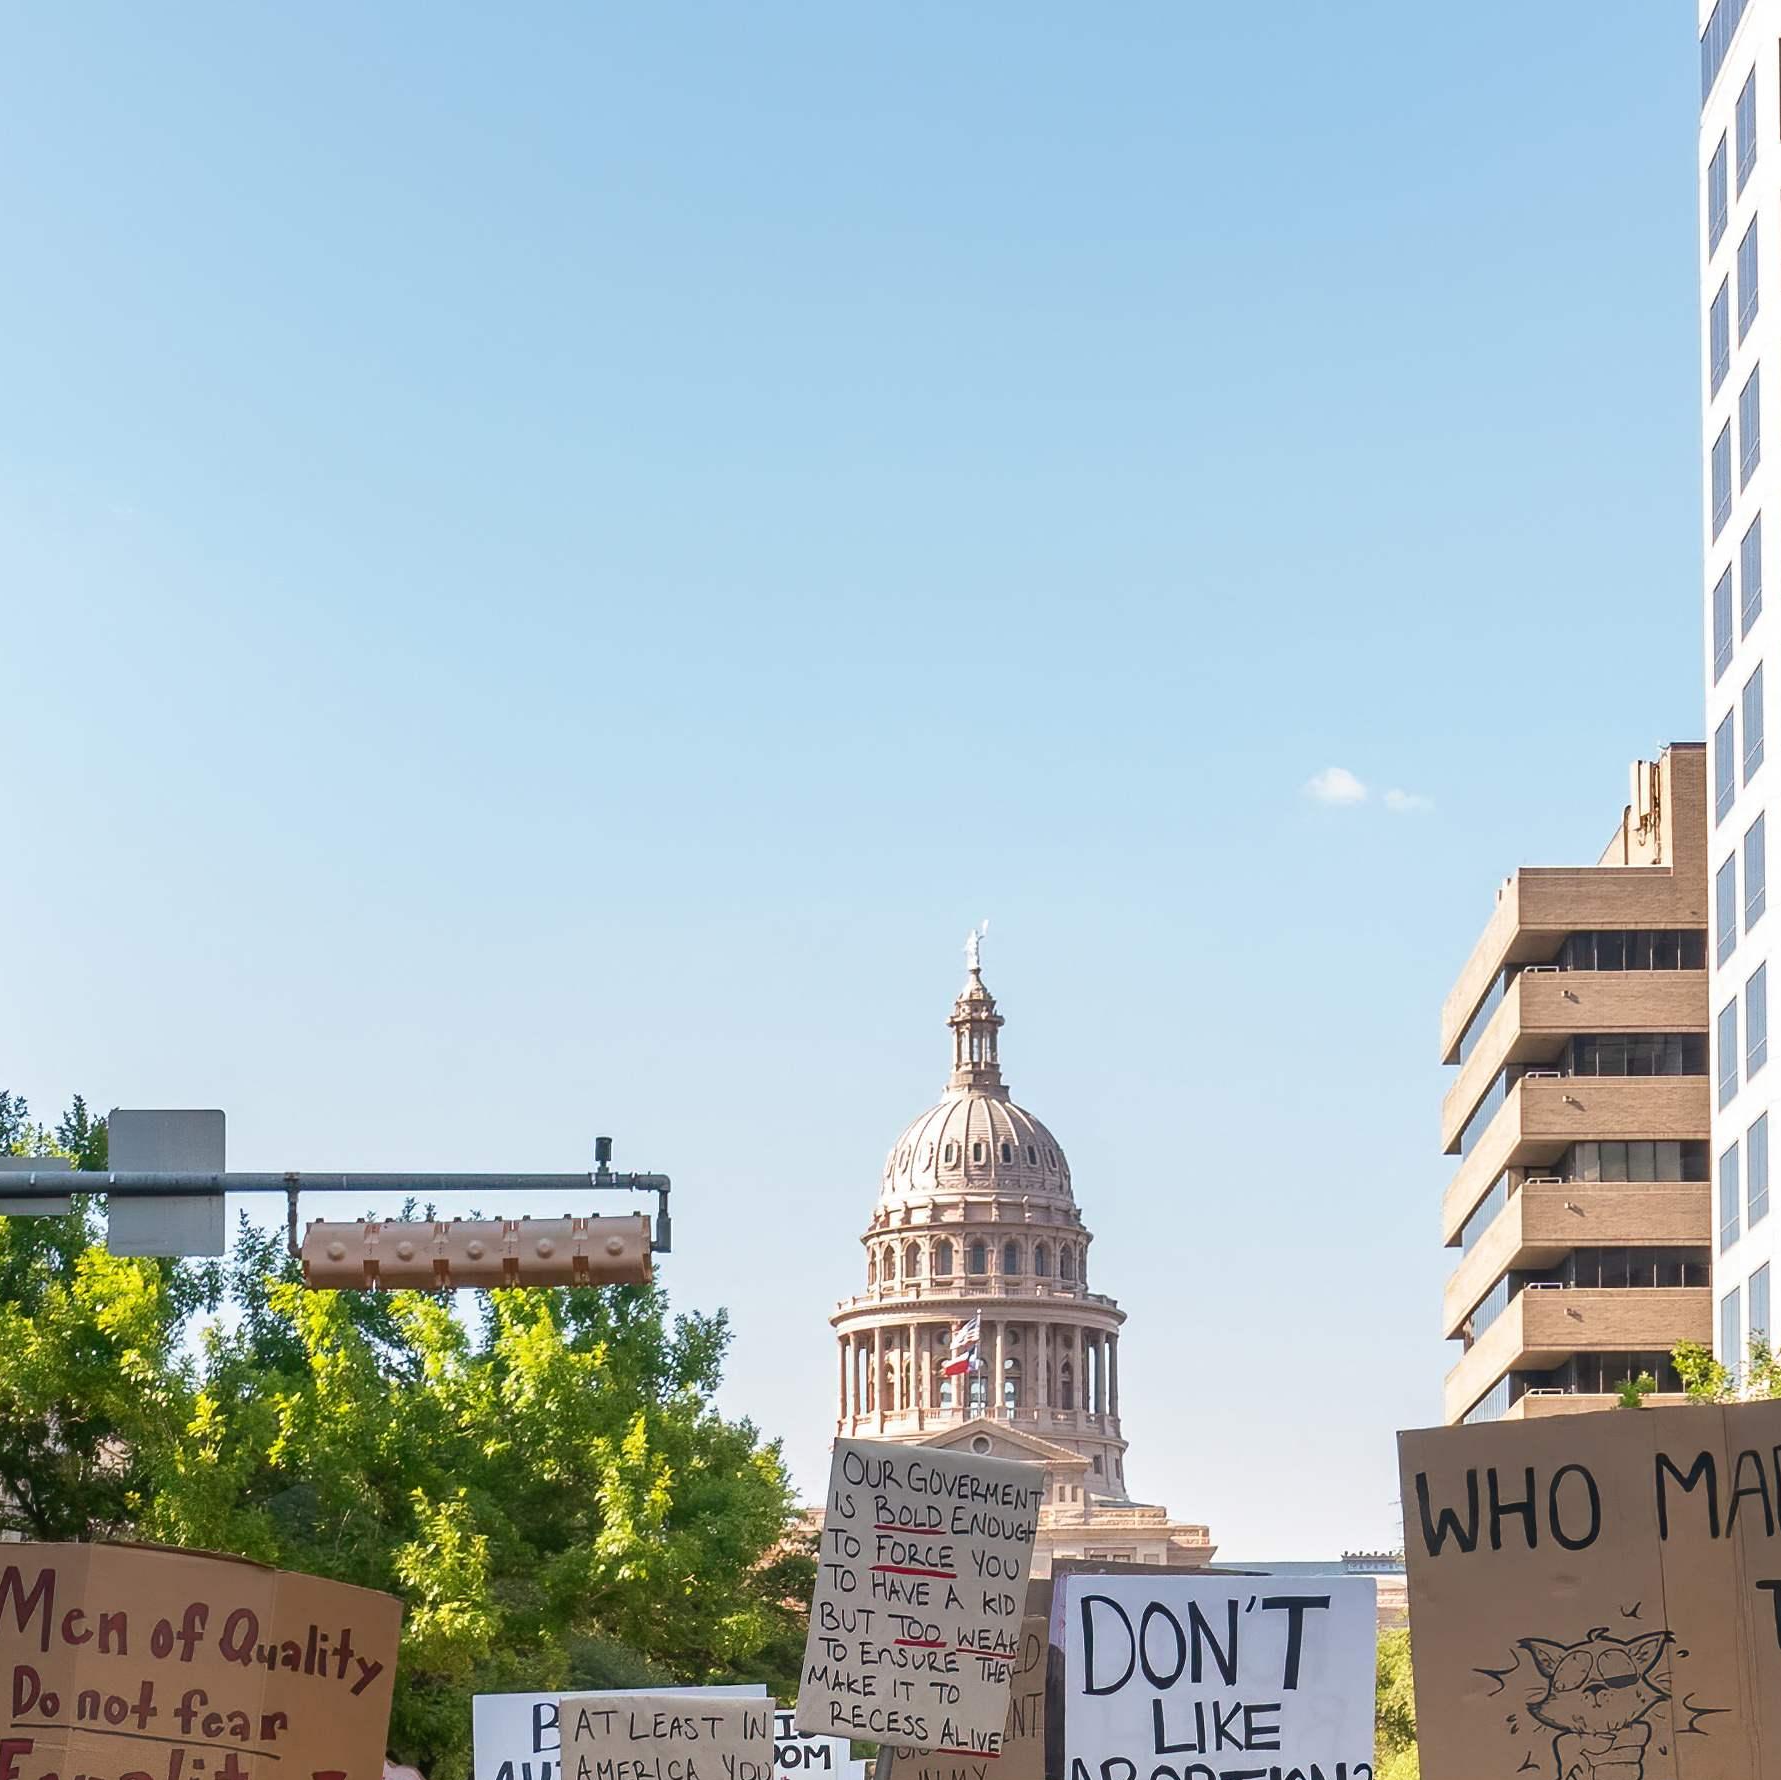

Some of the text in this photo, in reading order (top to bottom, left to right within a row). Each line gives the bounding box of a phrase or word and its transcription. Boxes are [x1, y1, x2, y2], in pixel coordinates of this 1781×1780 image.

[843, 1451, 1044, 1512] OUR GOVERMENT
[835, 1491, 1036, 1544] IS BOLD ENOUGH
[1416, 1462, 1602, 1556] WHO
[828, 1528, 1020, 1580] TO FORCE YOU
[824, 1563, 1016, 1617] TO HAVE A KID
[150, 1603, 209, 1662] of
[220, 1608, 383, 1696] Quality
[820, 1601, 1020, 1654] BUT TOO WEAK
[1080, 1594, 1331, 1696] DON'T
[807, 1665, 961, 1705] MAKE IT TO
[819, 1637, 848, 1662] TO
[975, 1656, 1016, 1683] THEY
[12, 1665, 287, 1742] Do not fear
[575, 1708, 618, 1742] AT
[629, 1710, 724, 1741] LEAST
[743, 1709, 767, 1740] IN
[830, 1702, 929, 1741] RECESS
[940, 1719, 1003, 1754] ALIVE
[1152, 1698, 1281, 1755] LIKE
